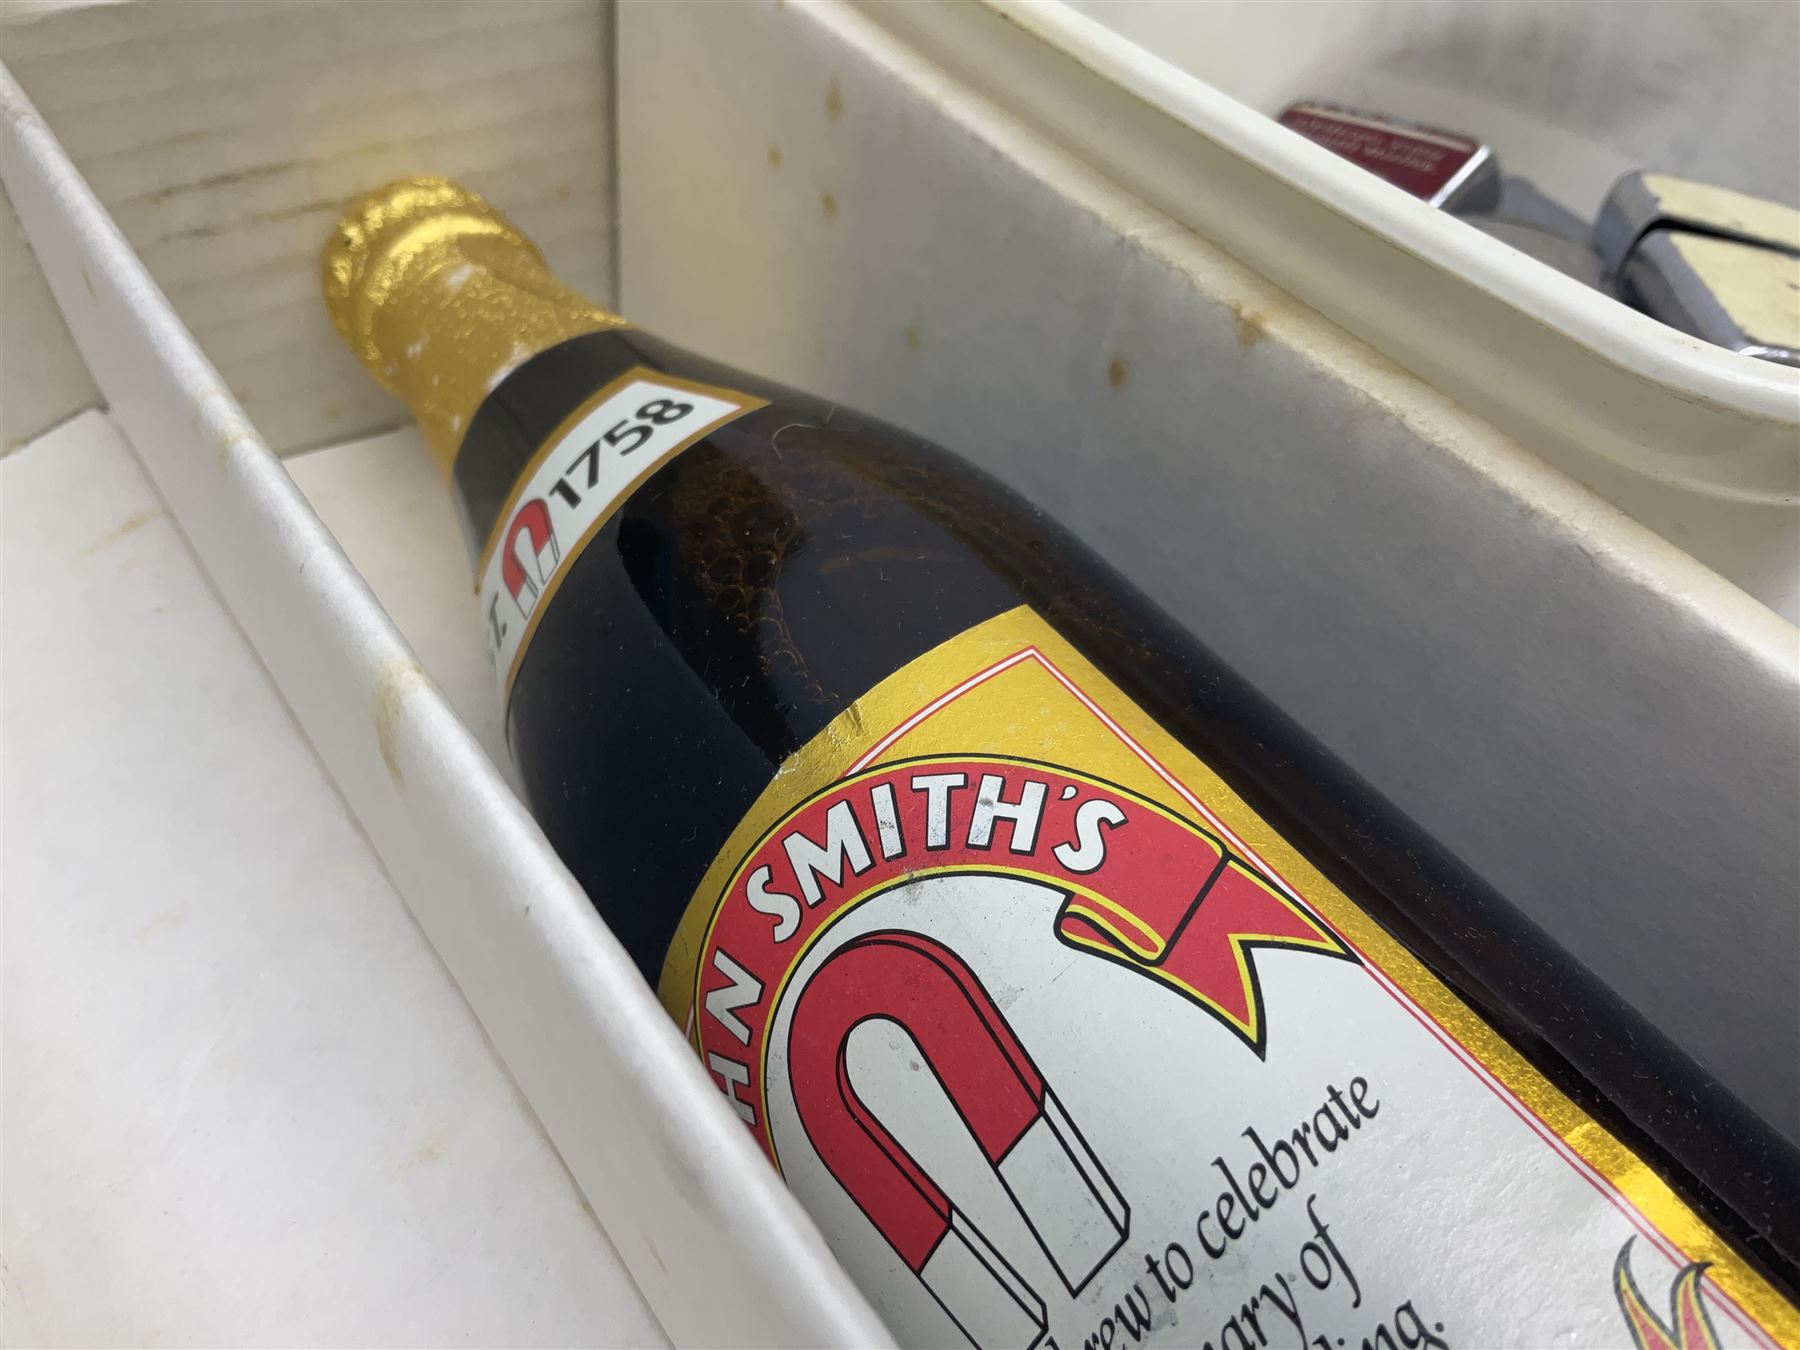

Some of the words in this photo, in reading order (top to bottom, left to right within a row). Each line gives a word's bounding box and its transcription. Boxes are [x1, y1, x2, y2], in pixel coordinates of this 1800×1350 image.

[548, 398, 695, 510] 1758
[704, 945, 767, 1127] HN
[744, 772, 1130, 953] SMITH'S
[1144, 1241, 1195, 1303] to
[1196, 1075, 1381, 1260] celebrate
[1203, 1272, 1308, 1350] ary
[1300, 1193, 1362, 1309] of
